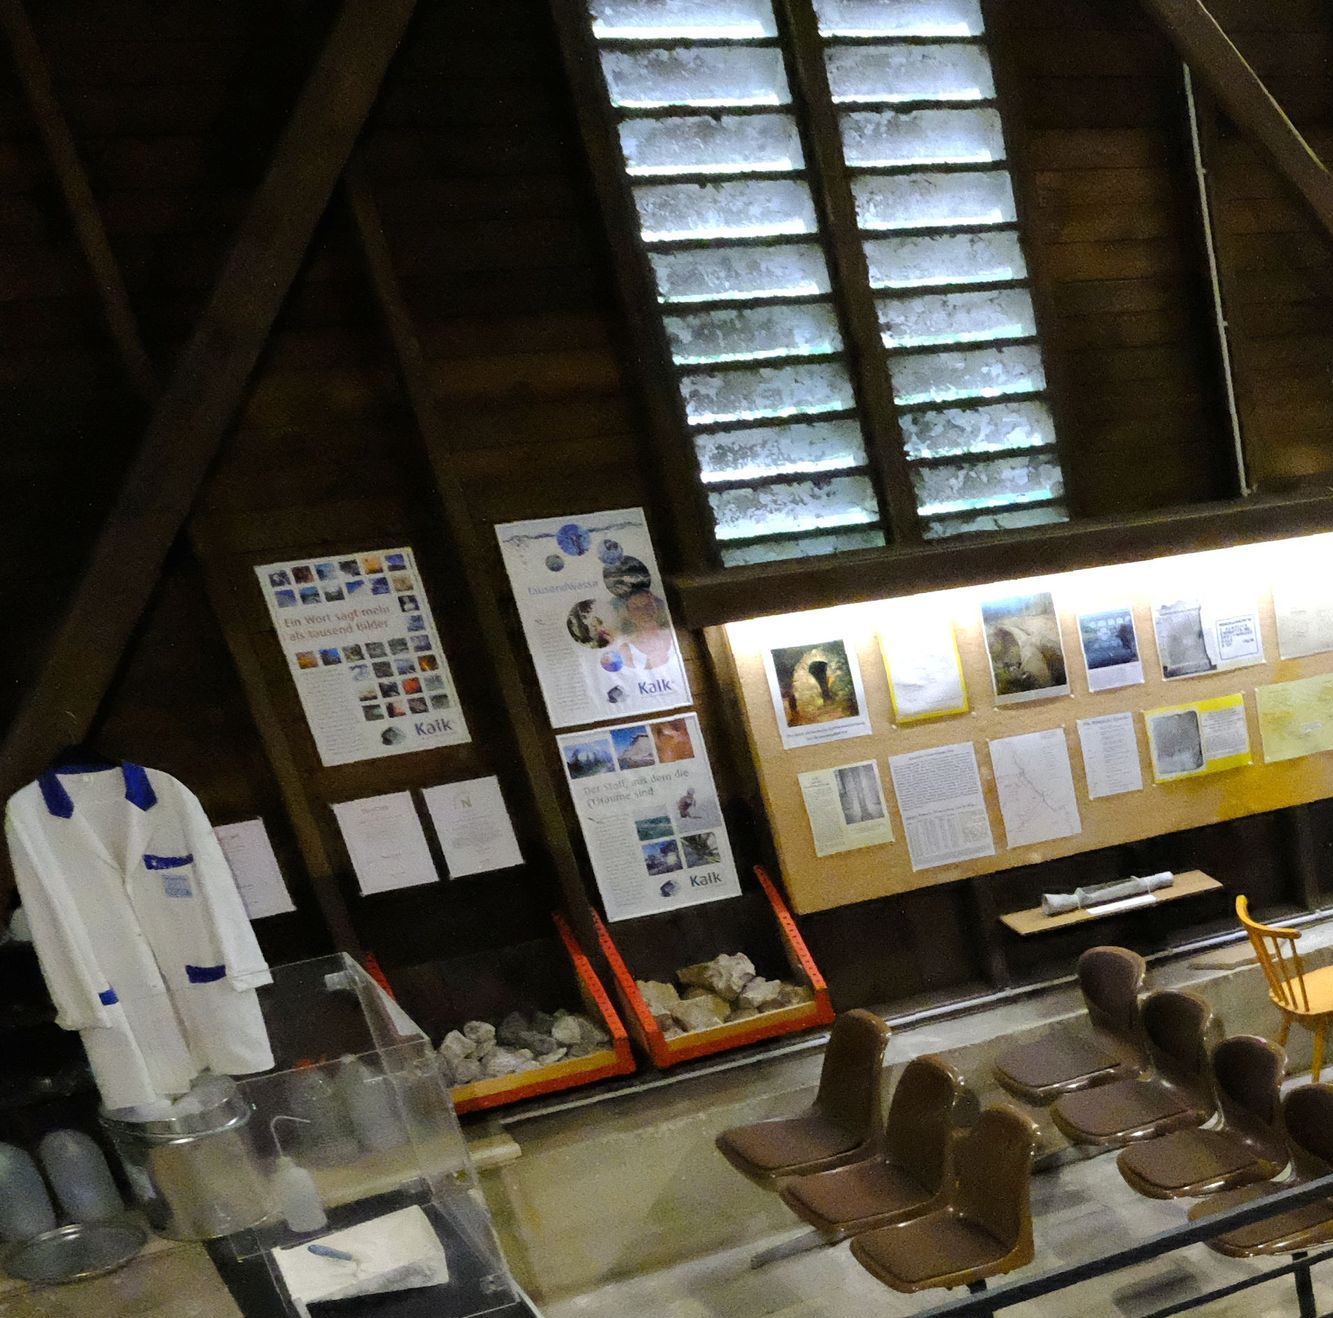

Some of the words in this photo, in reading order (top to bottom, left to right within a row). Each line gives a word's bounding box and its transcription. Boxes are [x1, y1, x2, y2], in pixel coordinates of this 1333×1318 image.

[284, 617, 301, 628] Ein
[304, 613, 331, 625] Wort
[335, 608, 358, 622] sagt
[289, 630, 305, 642] als
[308, 622, 354, 640] tausend
[637, 678, 673, 695] Kalk
[414, 717, 452, 736] Kalk
[674, 768, 689, 780] die
[690, 871, 722, 888] Kalk
